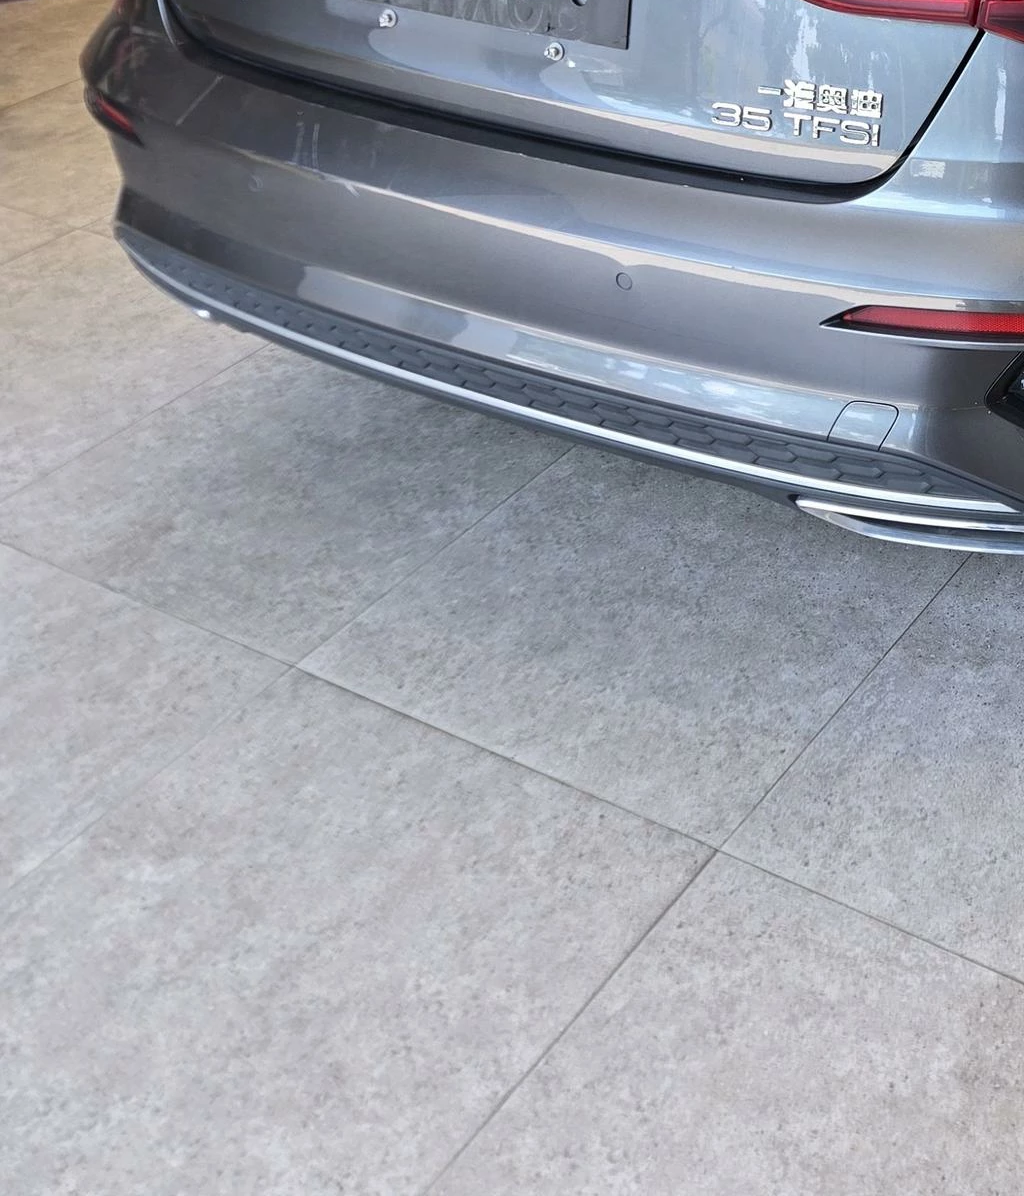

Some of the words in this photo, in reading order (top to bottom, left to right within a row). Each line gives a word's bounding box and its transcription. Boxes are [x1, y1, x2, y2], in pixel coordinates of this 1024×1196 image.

[758, 79, 883, 119] 一汽奥迪
[711, 102, 772, 131] 35
[783, 112, 880, 147] TFSI
